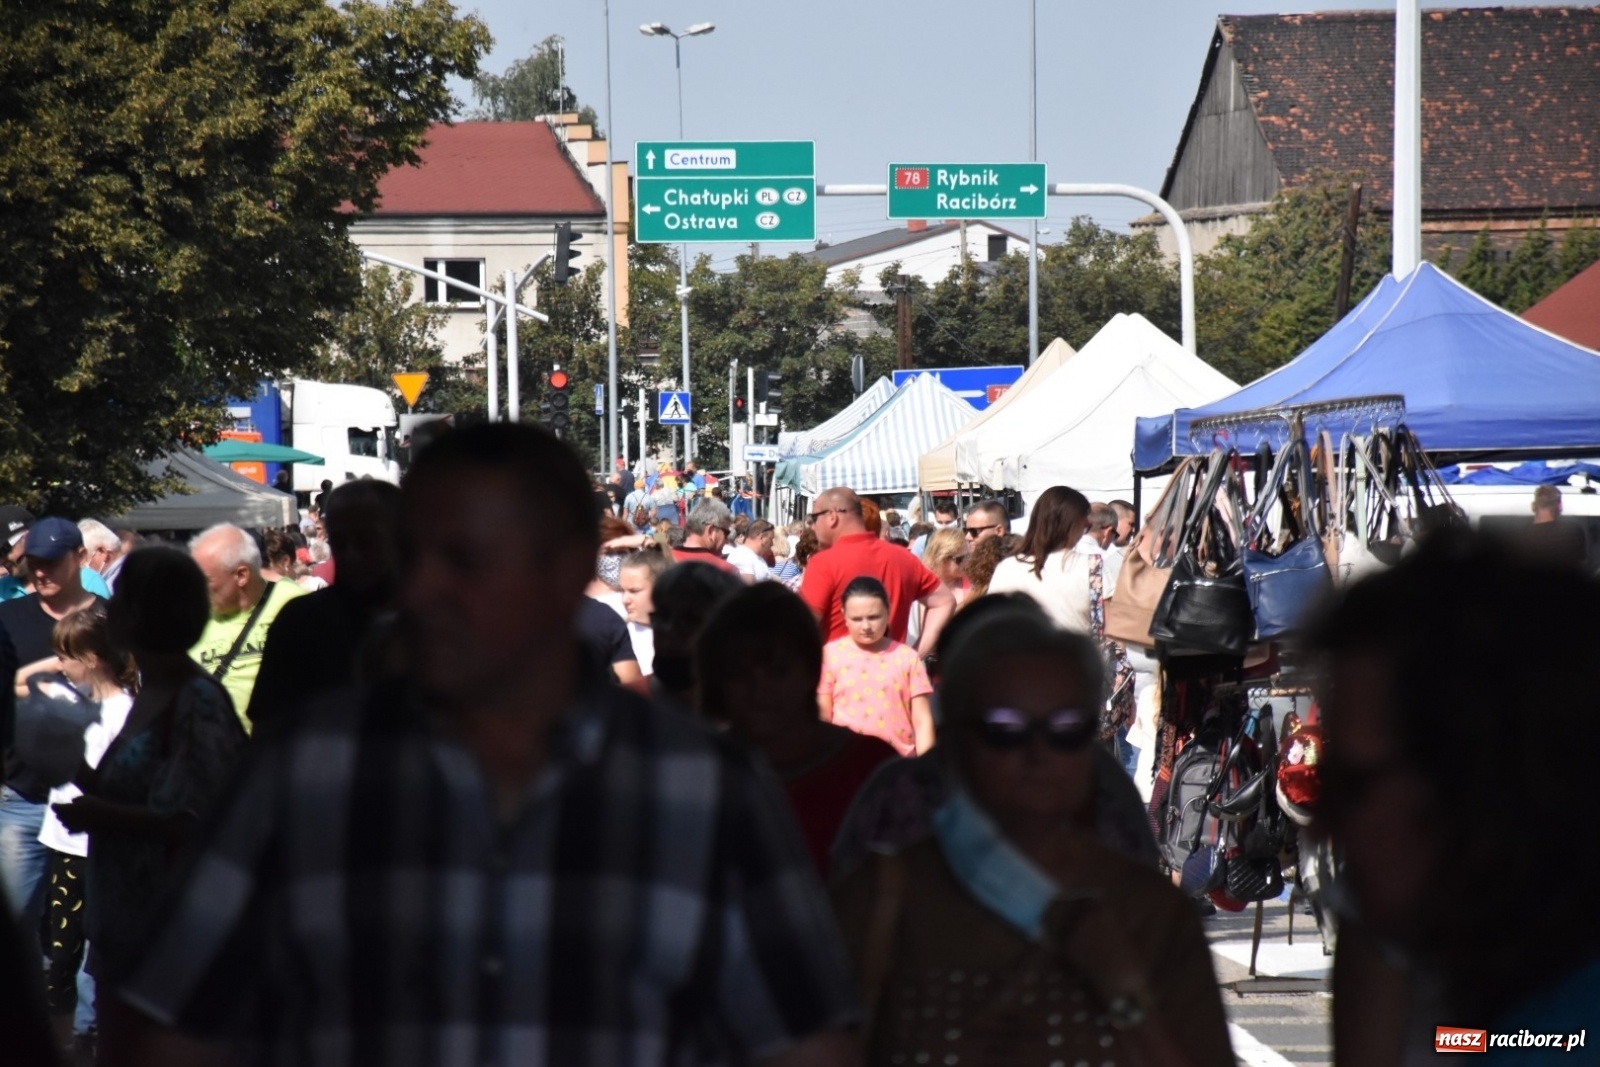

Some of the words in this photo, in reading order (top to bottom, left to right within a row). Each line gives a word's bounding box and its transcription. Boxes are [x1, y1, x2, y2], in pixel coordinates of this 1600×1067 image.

[670, 153, 731, 166] Centrum
[904, 171, 921, 186] 78
[936, 169, 999, 190] Rybnik
[663, 188, 749, 210] Chałupki
[761, 191, 774, 202] PL
[787, 191, 802, 202] CZ
[936, 193, 1017, 210] Racibórz
[664, 212, 738, 230] Ostrava
[760, 215, 775, 226] CZ
